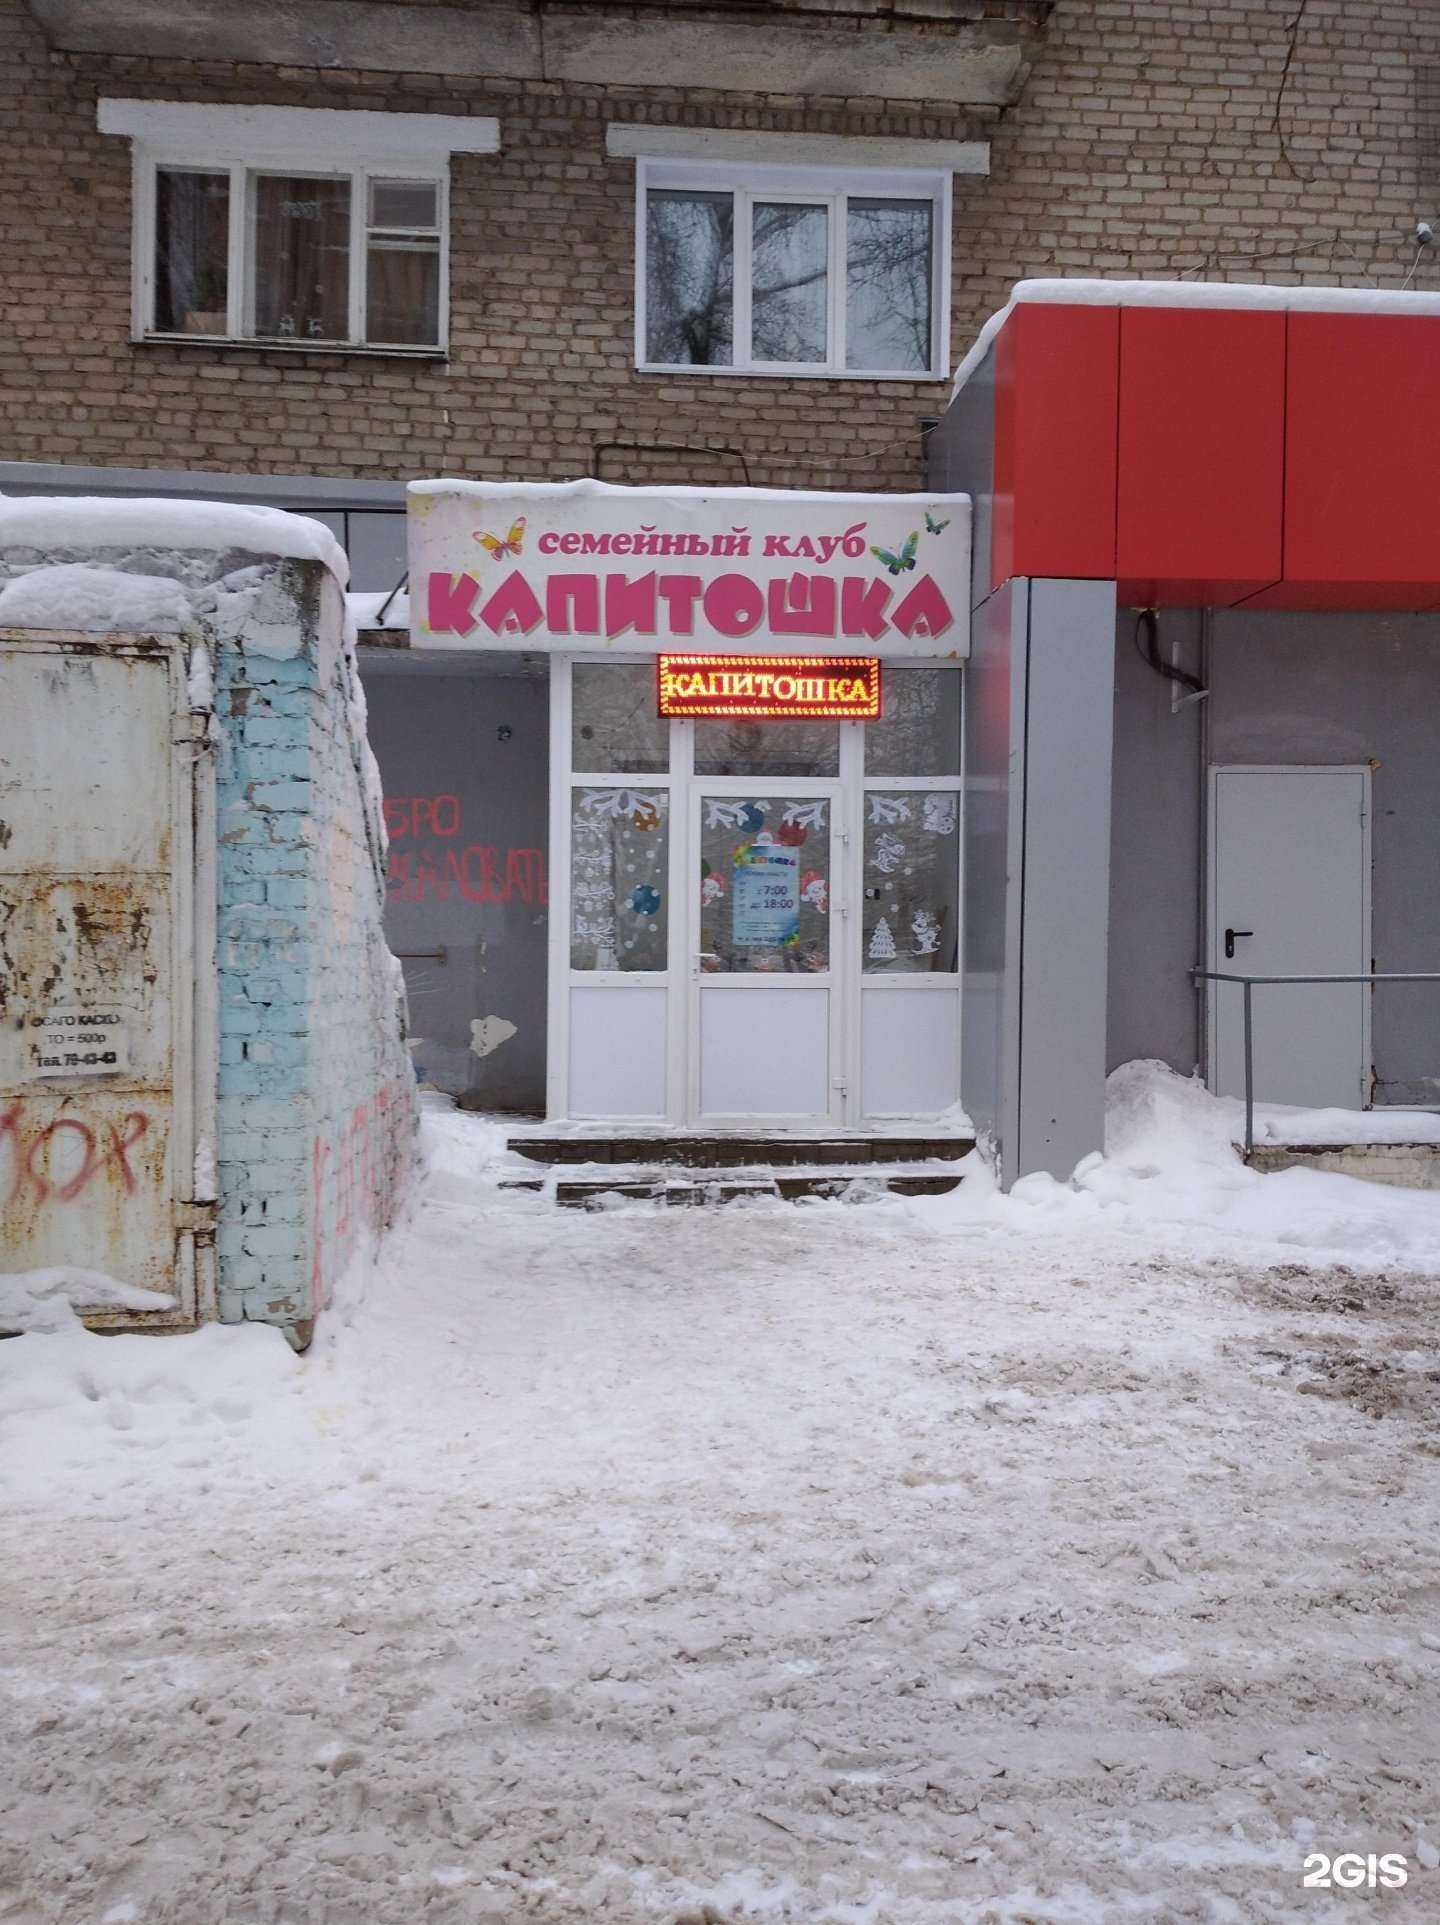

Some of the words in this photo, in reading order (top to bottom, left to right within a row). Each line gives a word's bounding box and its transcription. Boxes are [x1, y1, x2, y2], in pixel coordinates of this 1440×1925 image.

[538, 524, 751, 558] семейный
[762, 521, 868, 564] клуб
[427, 569, 955, 639] КАПИТОШКА
[665, 672, 871, 702] КАПИТОШКА
[763, 899, 794, 909] 18:00
